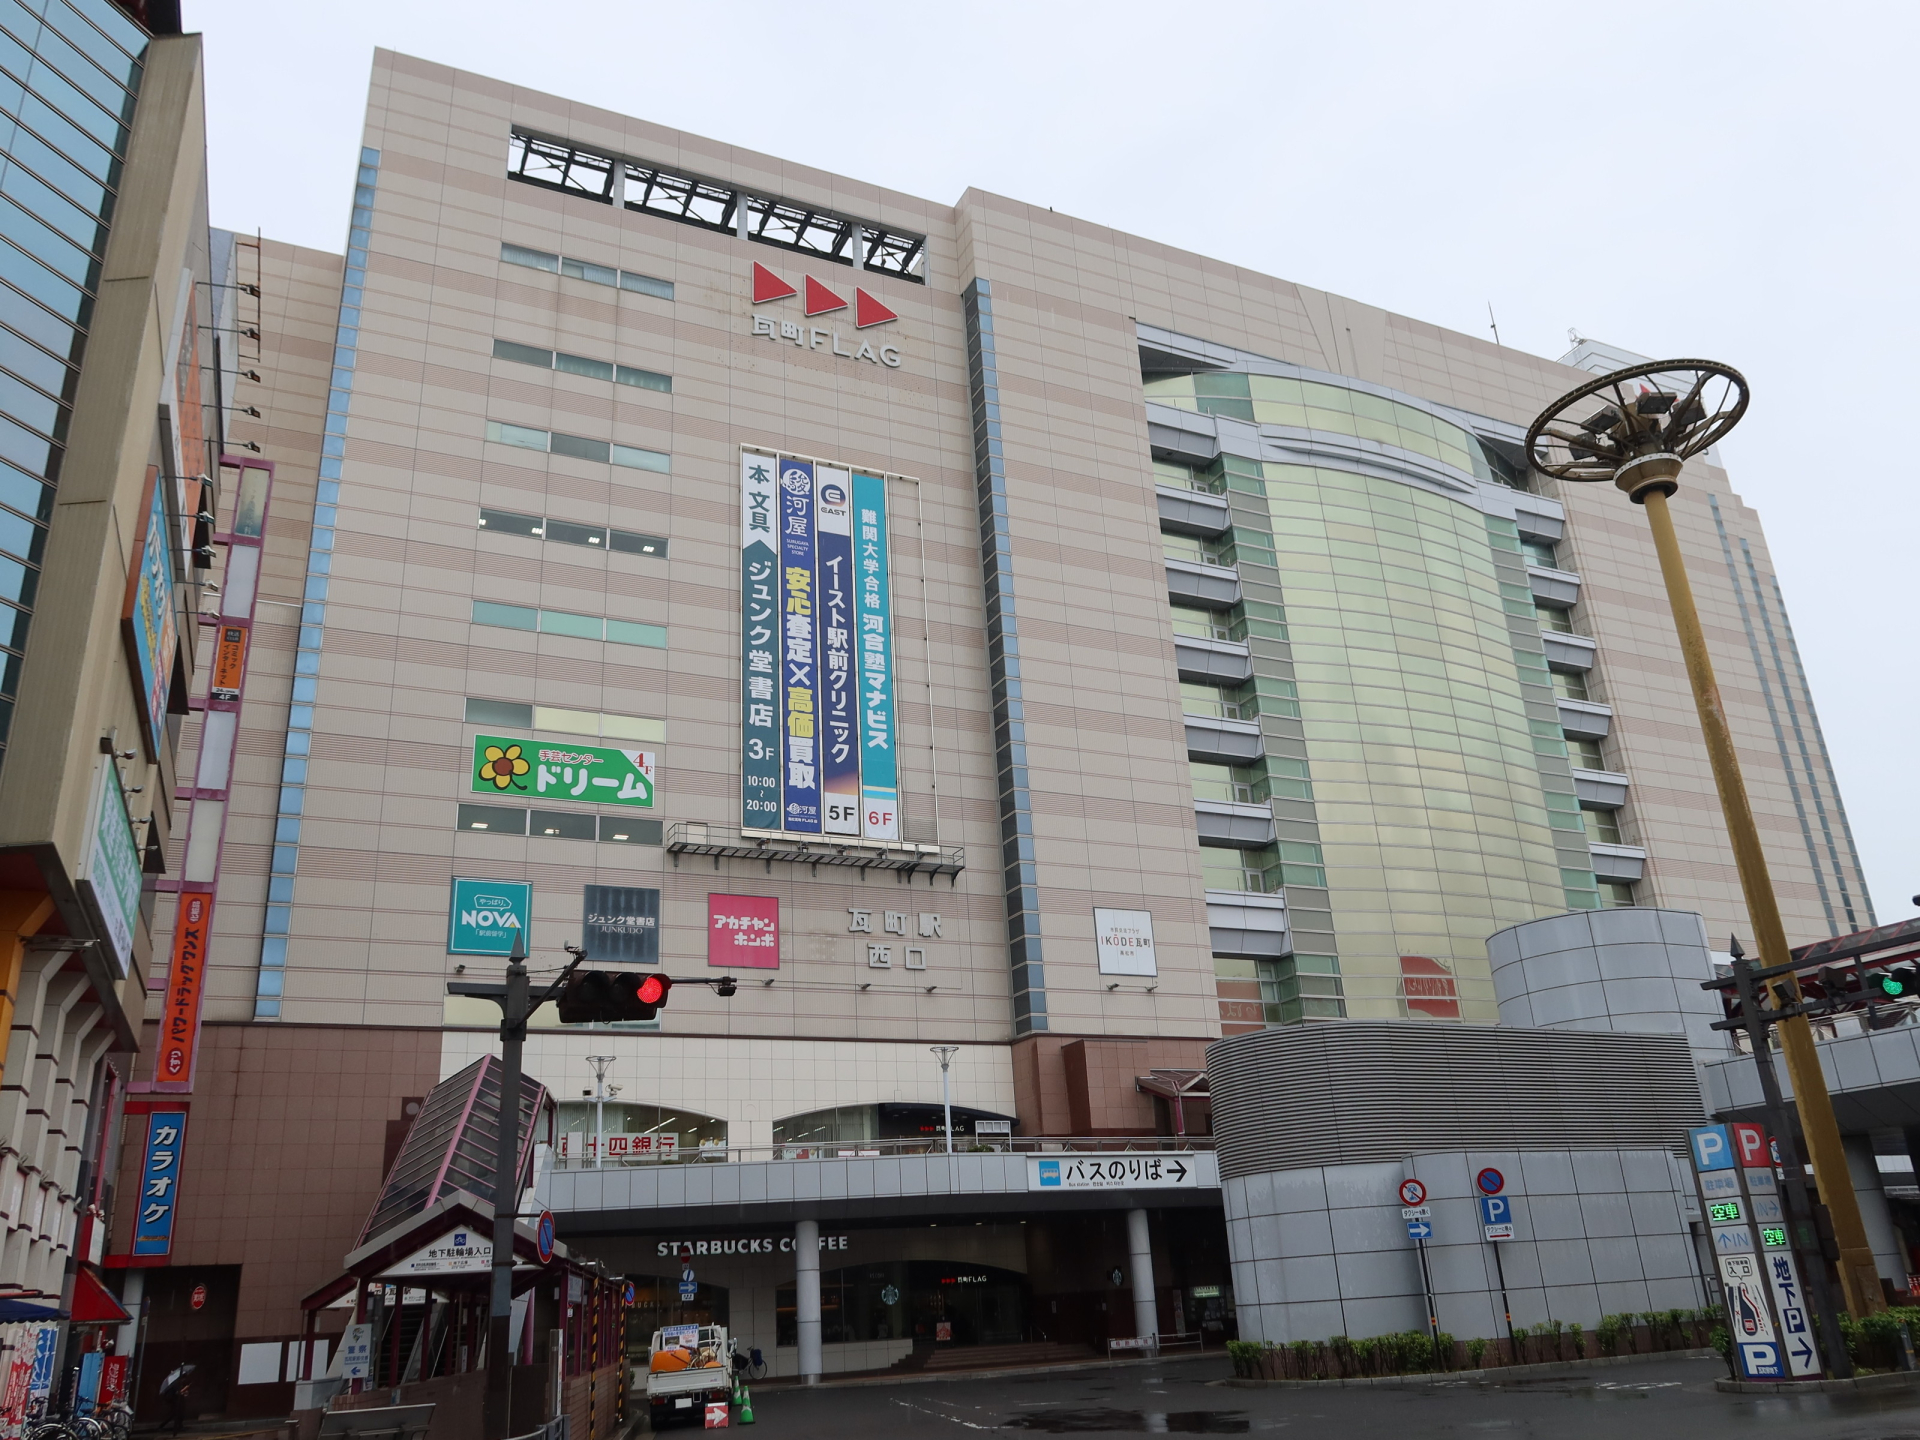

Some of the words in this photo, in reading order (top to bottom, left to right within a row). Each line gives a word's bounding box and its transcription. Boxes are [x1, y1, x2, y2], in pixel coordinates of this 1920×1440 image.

[751, 313, 901, 367] 瓦町FLAG
[748, 465, 770, 485] 本
[748, 491, 771, 533] 文具
[780, 468, 811, 538] 駿河屋
[861, 508, 880, 609] 難関大学合格
[748, 560, 773, 728] ジュンク堂書店
[825, 555, 850, 764] イースト駅前クリニック
[862, 613, 889, 751] 河合塾マナビス
[538, 749, 604, 765] 手芸センター
[748, 738, 775, 760] 3F
[632, 752, 653, 775] 4F
[536, 764, 648, 800] ドリーム
[747, 775, 776, 788] 10:00
[746, 800, 777, 812] 20:00
[829, 805, 855, 821] 5F
[868, 811, 893, 826] 6F
[461, 910, 522, 928] NOVA
[587, 913, 656, 927] ジュンク堂書店
[847, 907, 943, 938] 瓦町駅
[600, 925, 643, 935] JUNKUDO
[733, 931, 775, 947] ホンポ
[867, 943, 927, 971] 西口
[169, 1050, 182, 1074] くすり
[1696, 1132, 1723, 1165] P
[1739, 1129, 1761, 1160] P
[143, 1125, 179, 1224] カラオケ
[1066, 1158, 1163, 1181] バスのりば
[1710, 1202, 1739, 1221] 空車
[1756, 1203, 1769, 1217] IN
[657, 1238, 772, 1257] STARBUCKS
[779, 1236, 848, 1252] CFEE
[1732, 1232, 1749, 1247] IN
[1763, 1228, 1786, 1246] 空車
[428, 1246, 491, 1258] 地下駐輪場入口
[1729, 1265, 1750, 1275] 入口
[1742, 1344, 1776, 1375] P
